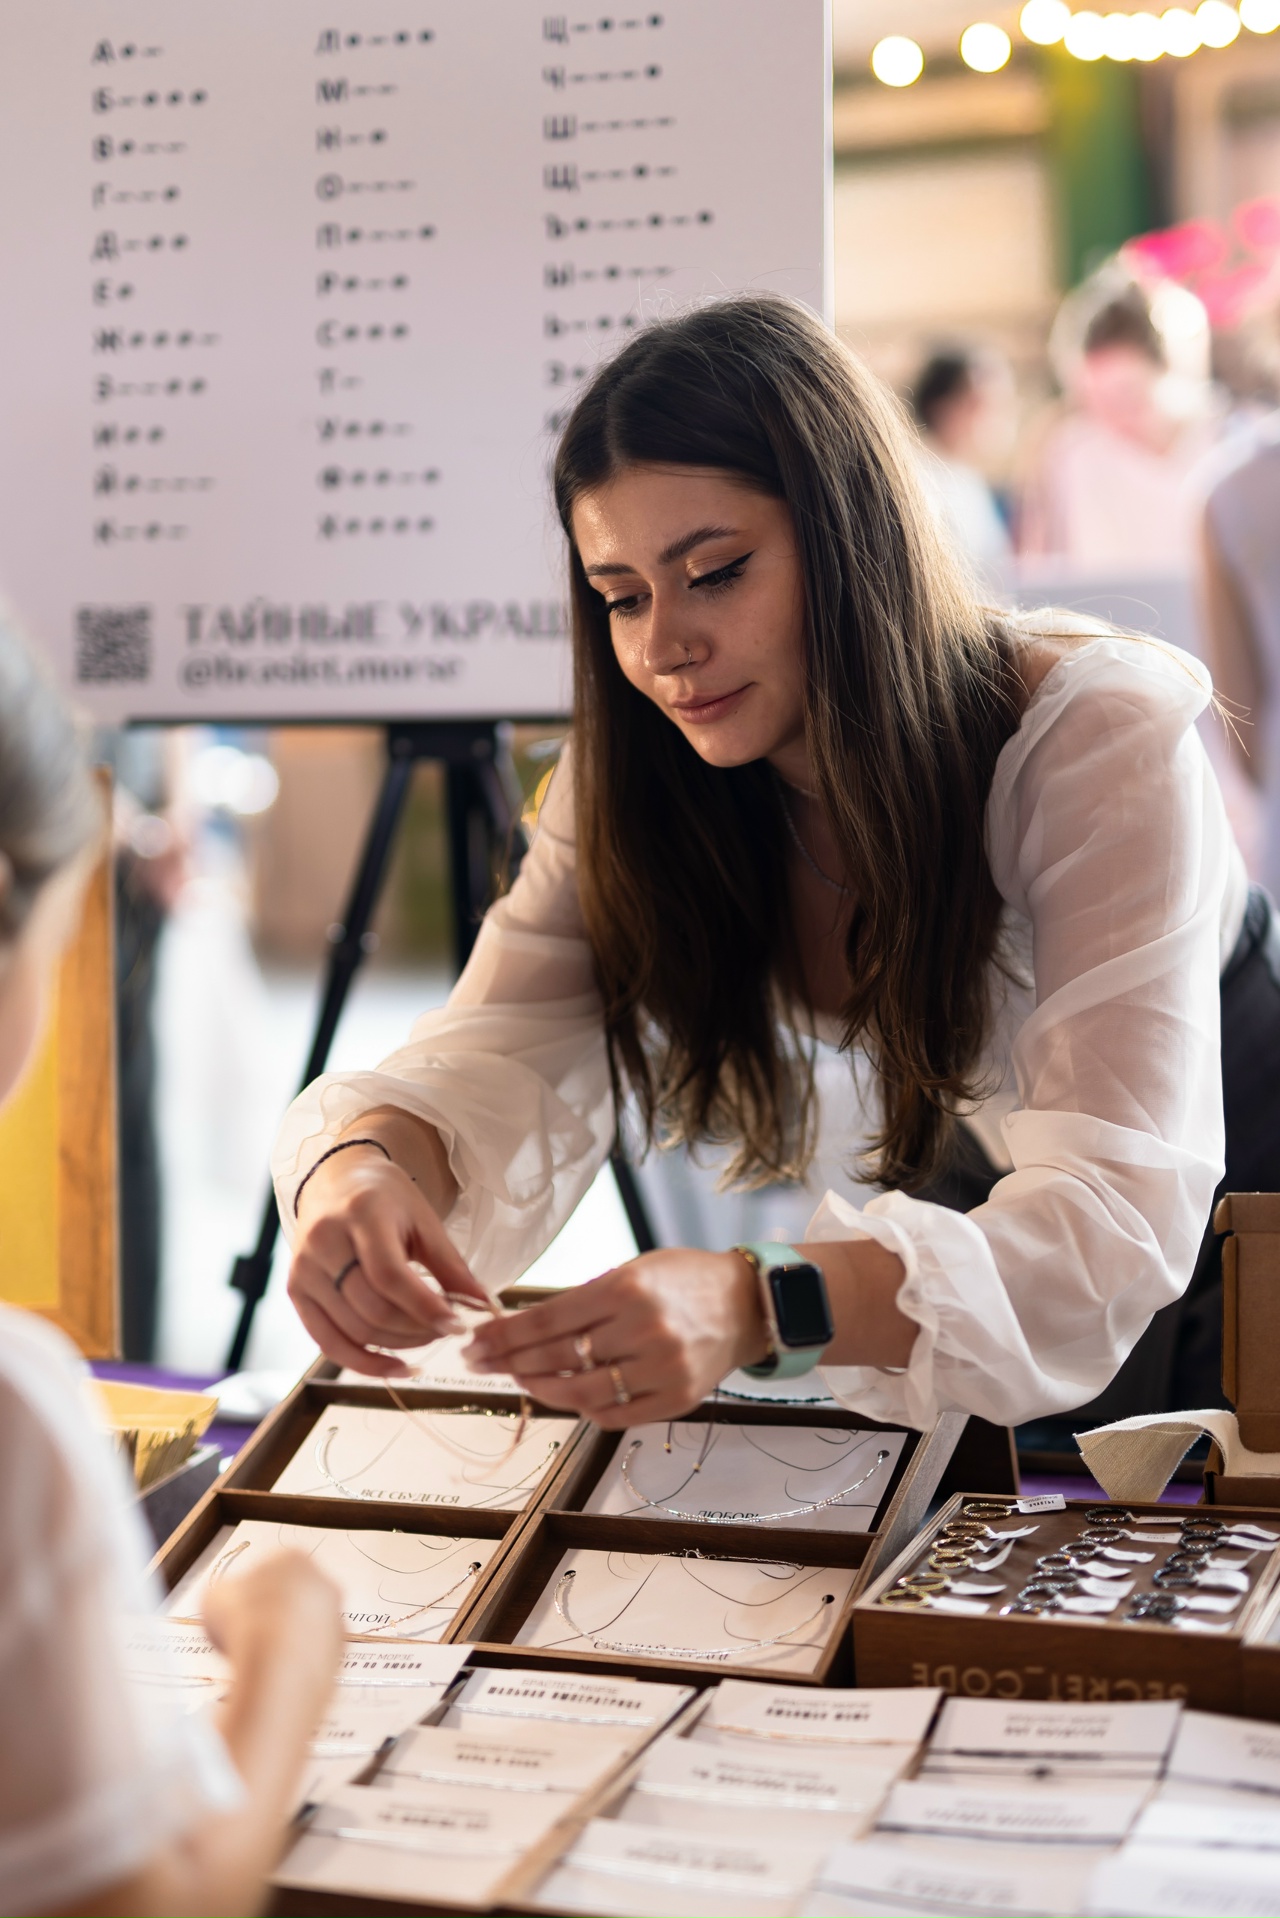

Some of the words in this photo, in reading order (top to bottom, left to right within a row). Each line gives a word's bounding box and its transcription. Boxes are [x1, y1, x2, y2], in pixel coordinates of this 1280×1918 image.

[180, 596, 386, 644] ТАЙНЫЕ
[360, 1489, 384, 1498] ВСЕ
[389, 1490, 460, 1504] СБУДЕТСЯ
[698, 1510, 760, 1520] ЛЮБОВ
[339, 1612, 390, 1624] ЕЧТОЙ
[522, 1678, 575, 1690] БРАСЛЕТ
